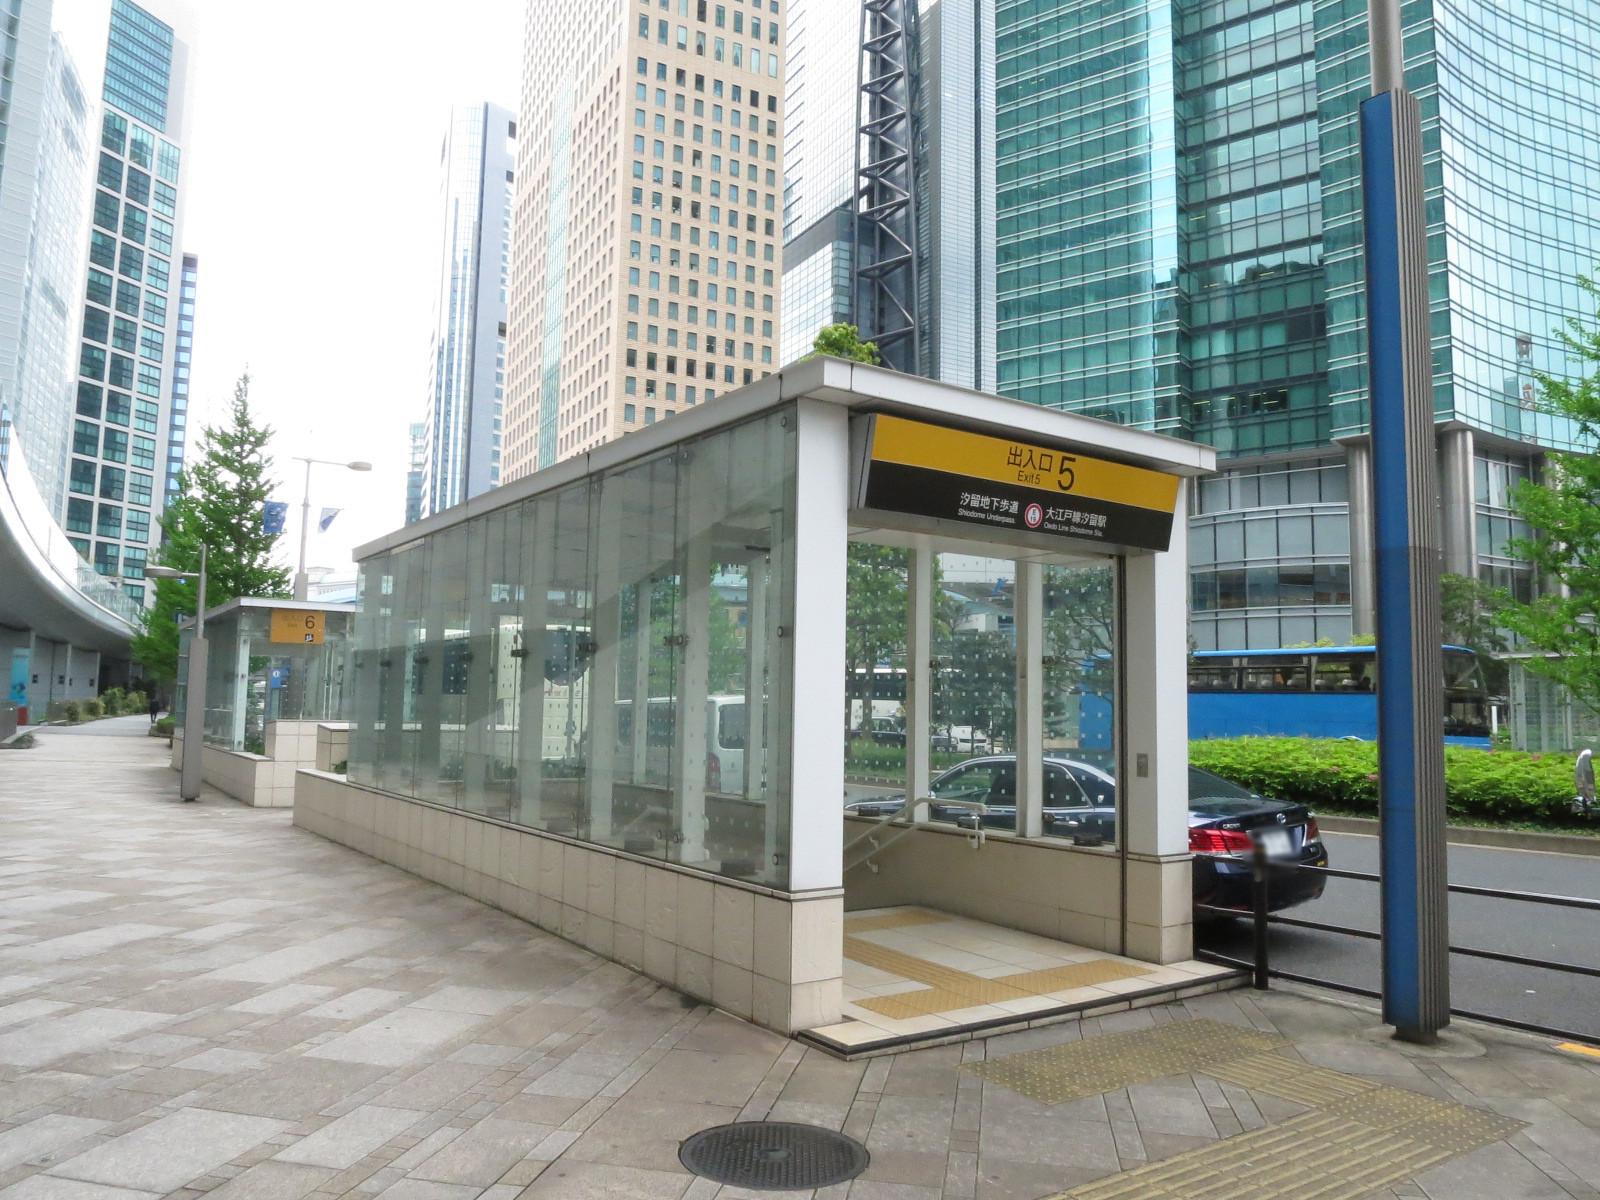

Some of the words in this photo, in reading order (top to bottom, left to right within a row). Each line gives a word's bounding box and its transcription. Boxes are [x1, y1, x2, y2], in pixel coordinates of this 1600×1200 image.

[1007, 446, 1053, 472] 出入口
[1057, 455, 1076, 491] 5
[957, 508, 986, 519] Shiodome
[960, 492, 1019, 514] 汐留地下歩道
[1045, 506, 1107, 528] 大江戸線汐留駅
[305, 615, 315, 629] 6
